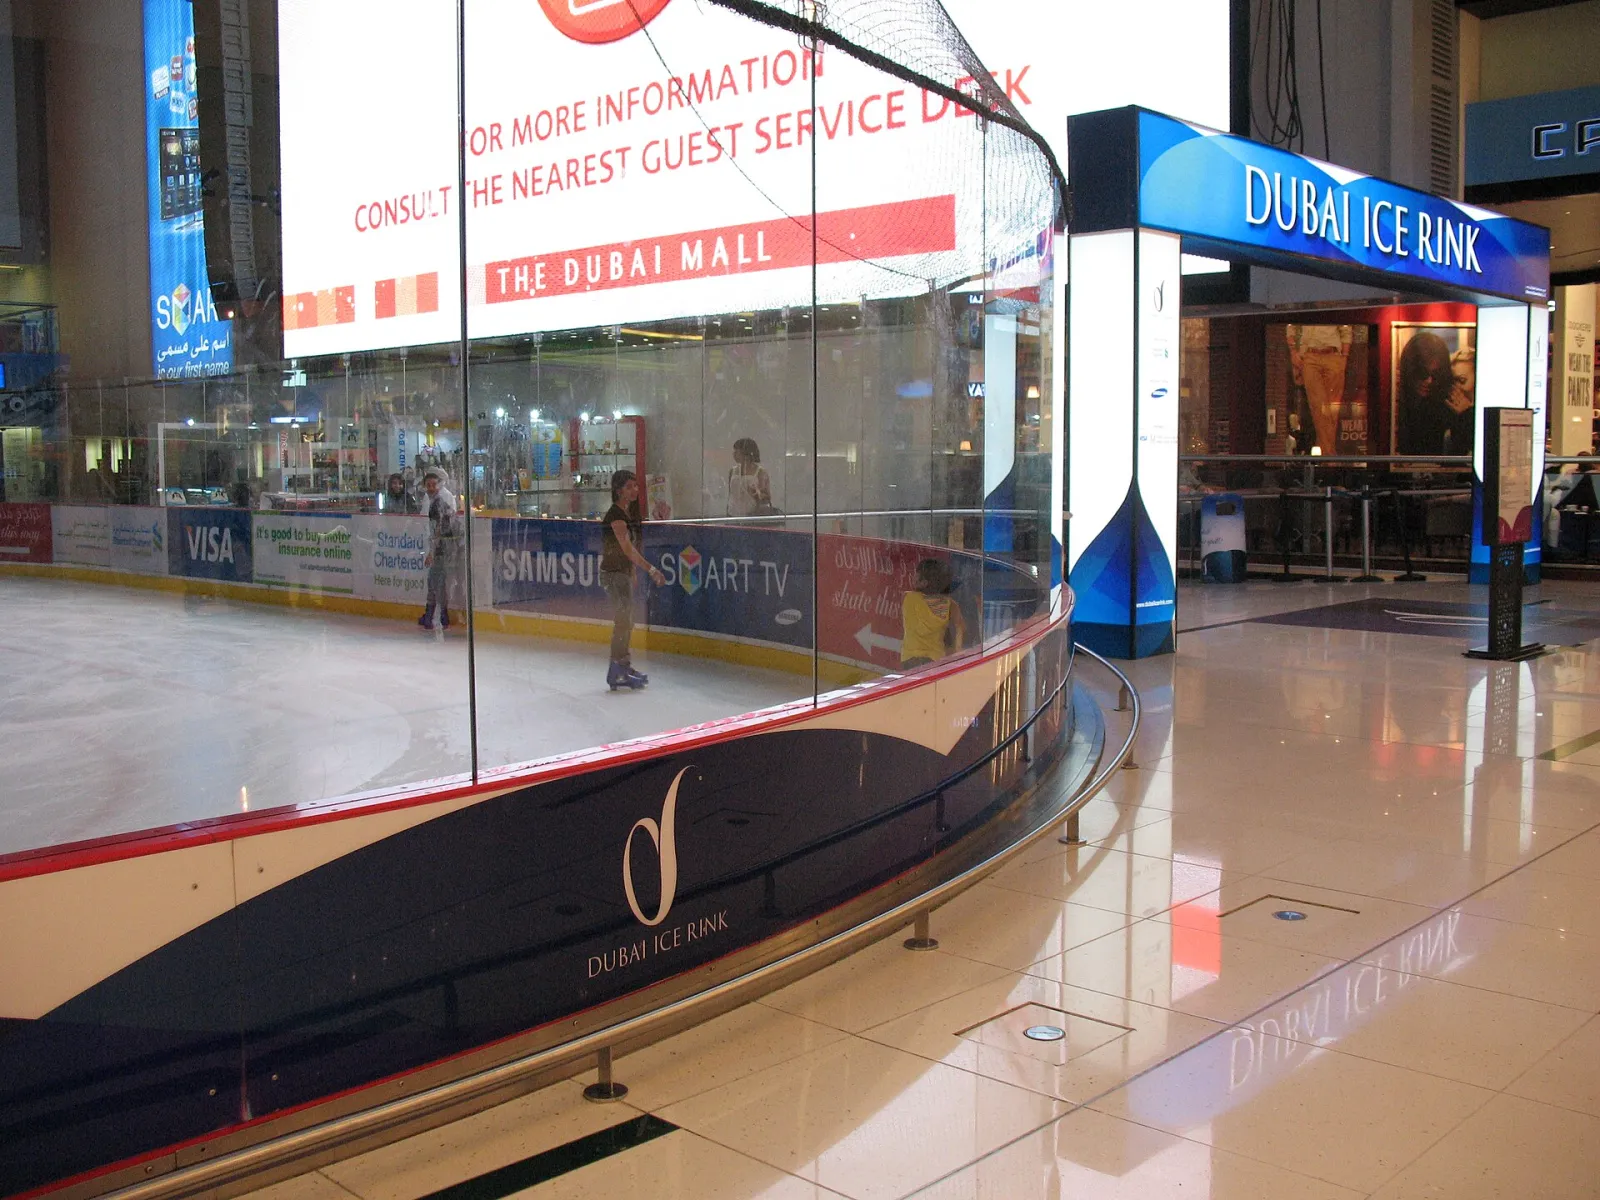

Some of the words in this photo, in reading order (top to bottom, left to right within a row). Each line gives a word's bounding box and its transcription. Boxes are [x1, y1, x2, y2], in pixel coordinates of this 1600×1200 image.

[460, 122, 503, 158] OR
[512, 100, 586, 147] MORE
[597, 44, 824, 127] INFORMATION
[354, 185, 452, 232] CONSULT
[464, 174, 503, 208] HE
[512, 146, 632, 201] NEAREST
[642, 123, 743, 174] GUEST
[754, 90, 906, 154] SERVICE
[921, 64, 1032, 123] DEK
[1245, 165, 1350, 243] DUBAI
[1363, 196, 1409, 257] ICE
[1417, 212, 1484, 274] RINK
[497, 262, 546, 295] THE
[564, 244, 662, 286] DUBAI
[681, 231, 771, 270] MALL
[185, 361, 203, 378] first
[204, 361, 230, 377] name
[1567, 376, 1591, 407] PANTS
[186, 525, 235, 565] VISA
[271, 526, 292, 542] good
[294, 527, 302, 540] to
[305, 527, 320, 545] buy
[278, 542, 320, 558] insurance
[323, 545, 352, 560] online
[377, 531, 424, 550] Standard
[374, 551, 424, 570] Chartered
[502, 548, 604, 587] SAMSU
[760, 560, 789, 598] TV
[832, 579, 872, 613] skate
[588, 939, 646, 978] DUBAI
[654, 927, 682, 955] ICE
[687, 910, 729, 942] RINK
